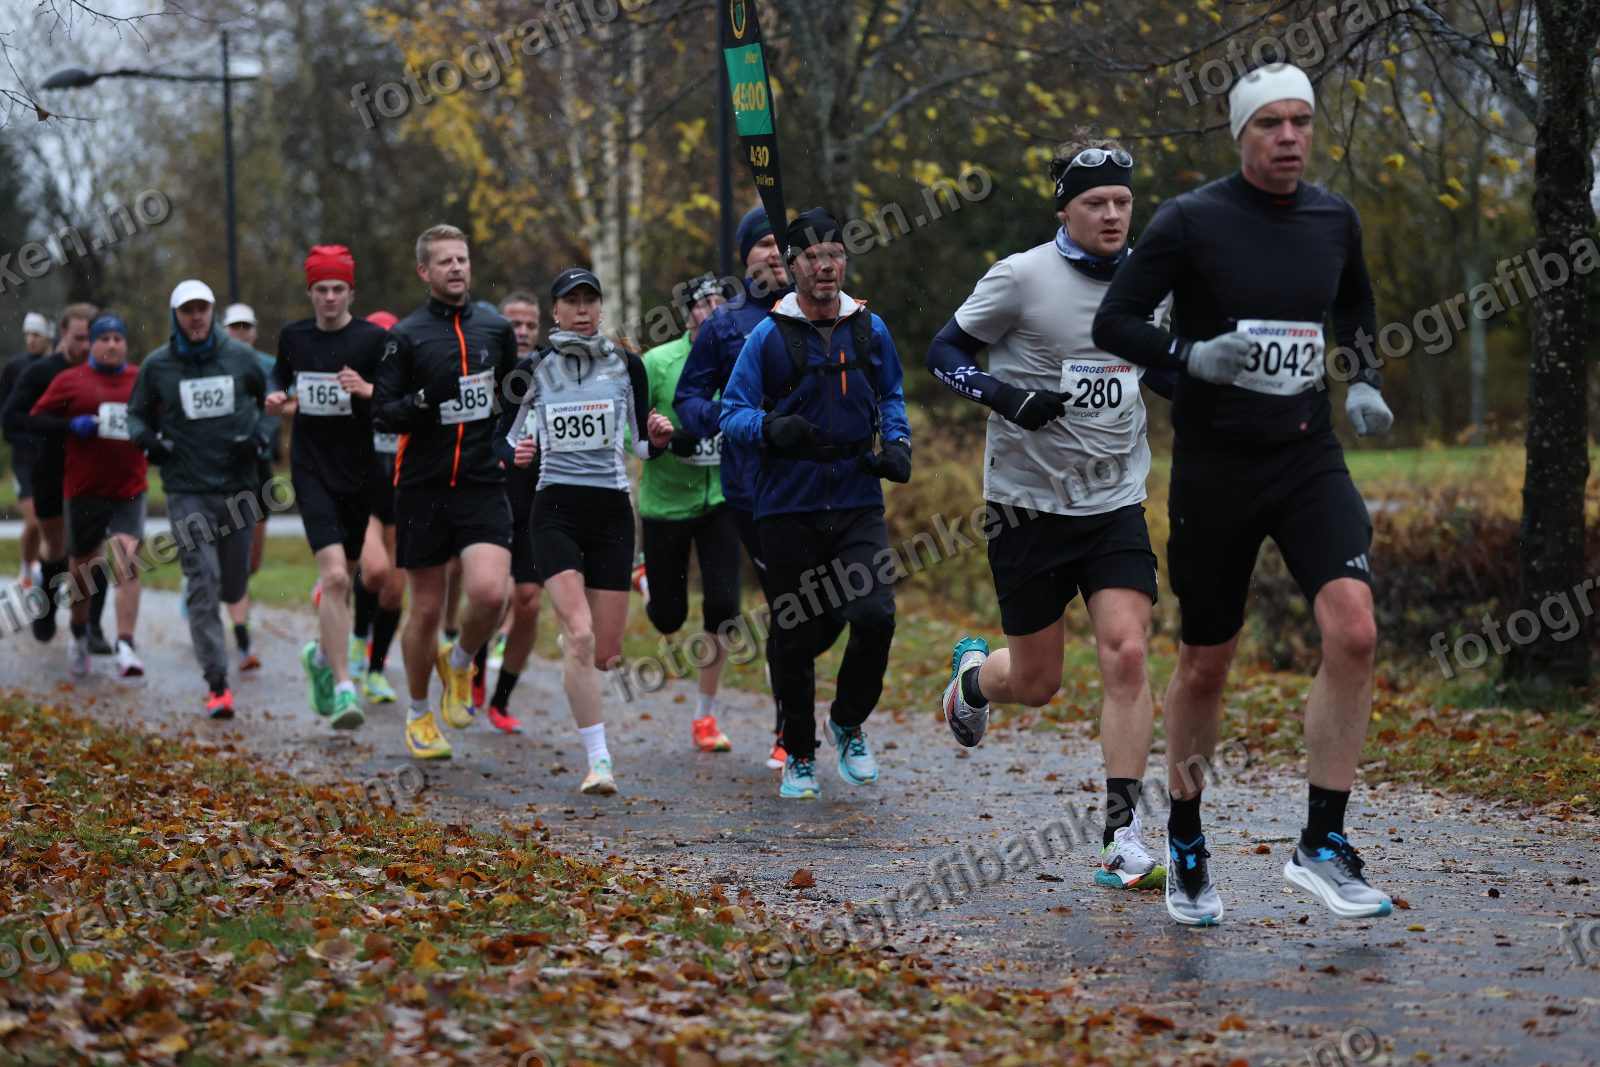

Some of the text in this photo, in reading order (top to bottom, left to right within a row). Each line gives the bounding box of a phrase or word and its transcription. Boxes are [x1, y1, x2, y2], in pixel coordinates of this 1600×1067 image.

[1069, 364, 1132, 374] NORGESTESTEN
[1245, 341, 1315, 377] 3042
[192, 388, 225, 409] 562
[308, 384, 339, 406] 165
[1073, 377, 1122, 409] 280
[552, 403, 609, 414] NORGESTESTEN
[553, 412, 606, 440] 9361
